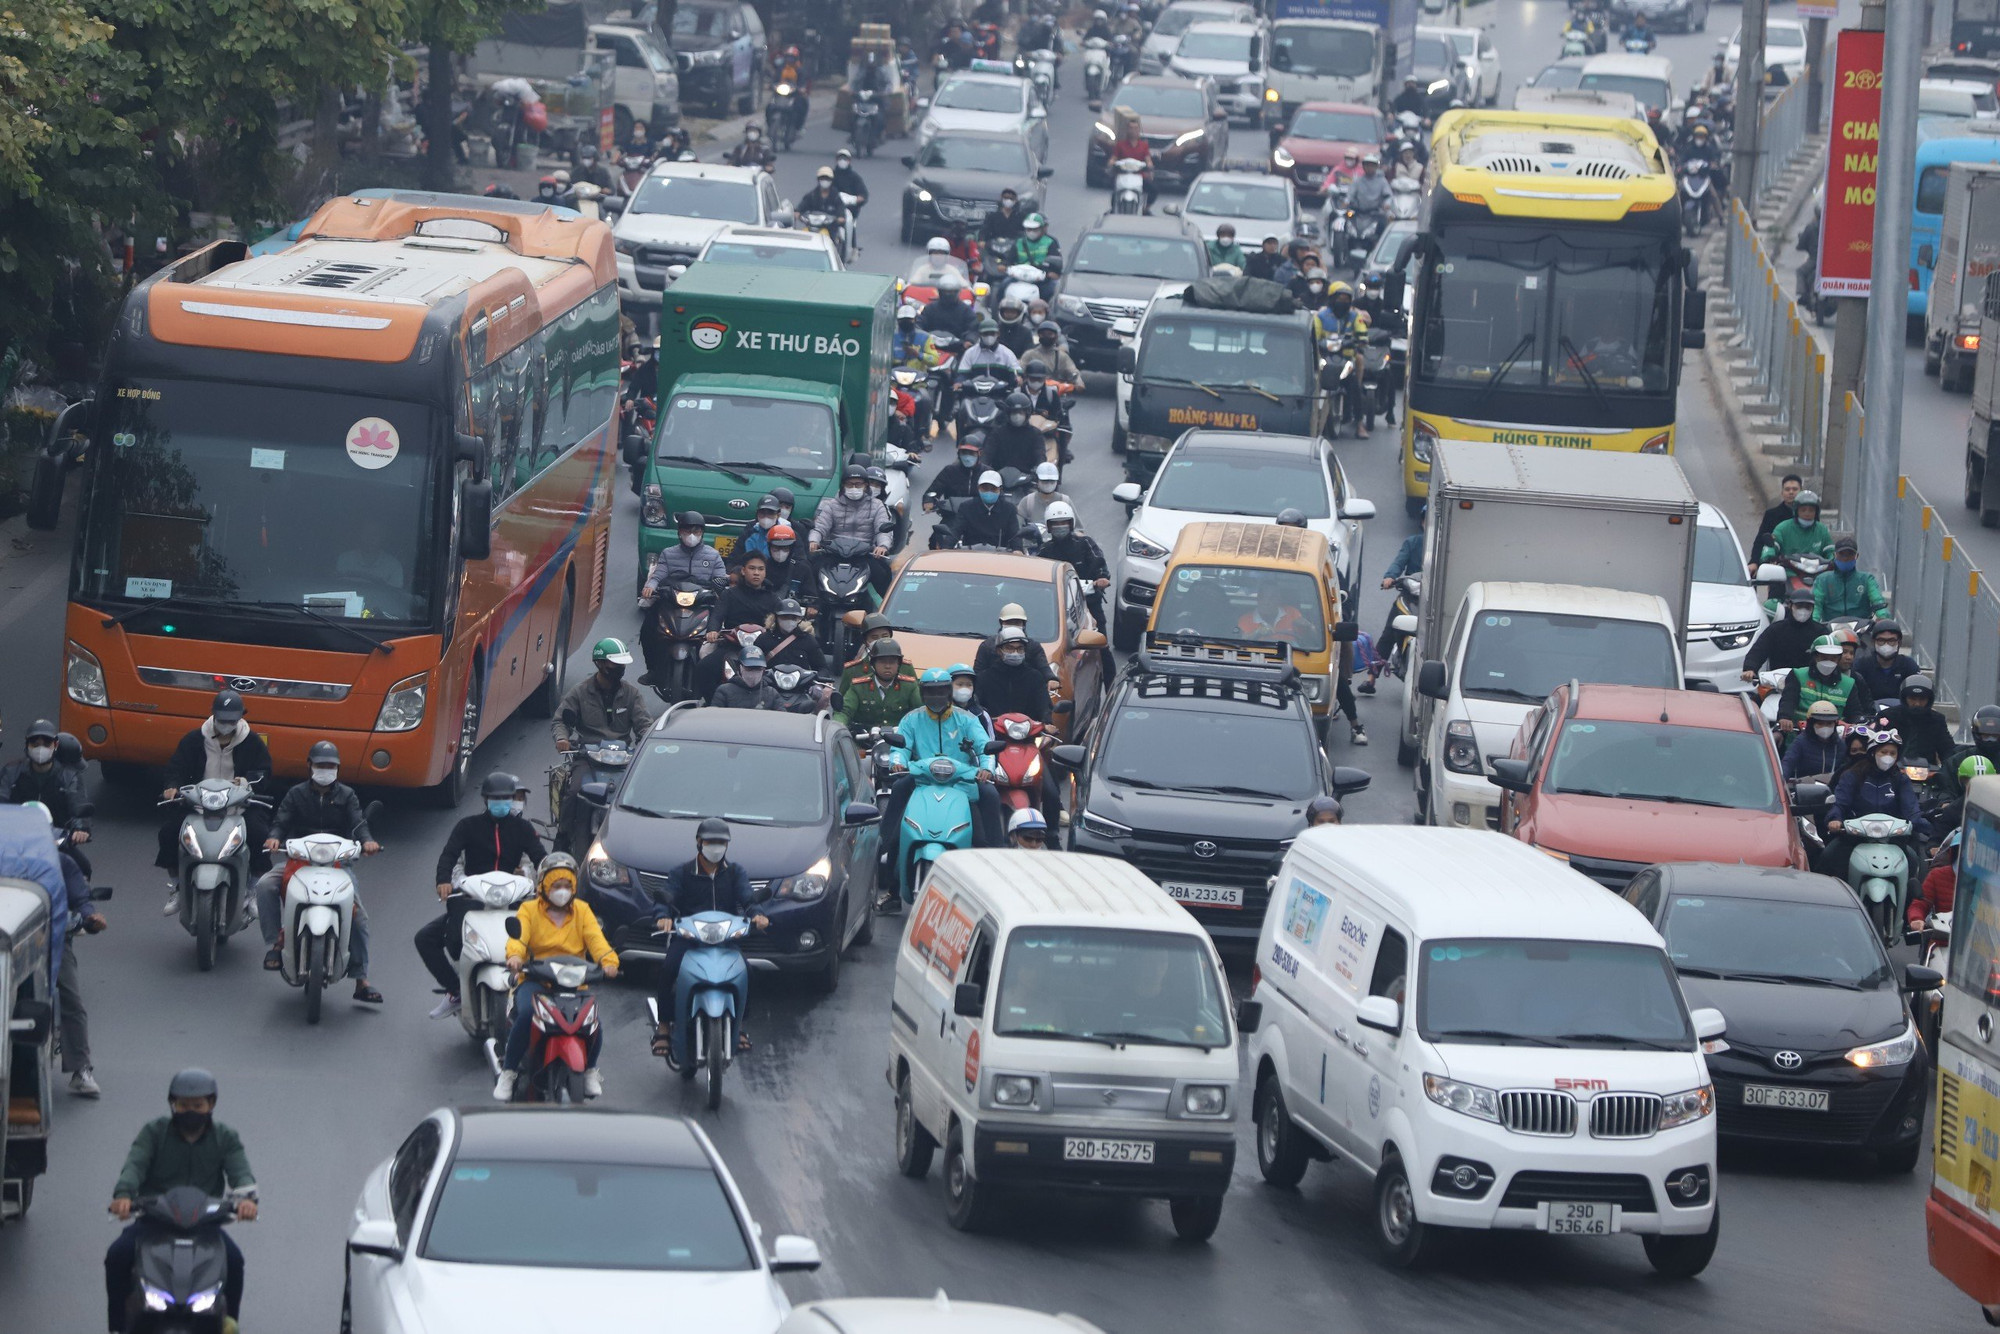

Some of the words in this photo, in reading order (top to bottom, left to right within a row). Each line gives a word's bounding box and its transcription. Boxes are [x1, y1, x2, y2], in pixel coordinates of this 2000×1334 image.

[1842, 118, 1879, 140] CHÀ
[736, 330, 762, 350] XE
[768, 333, 810, 353] THƯ
[814, 333, 860, 356] BÁO
[117, 388, 126, 397] XE
[127, 388, 141, 400] HỢP
[142, 388, 160, 400] ĐỒNG
[1213, 412, 1235, 428] MAI
[1240, 414, 1257, 430] KA
[1168, 886, 1236, 902] 28A-233.45
[1554, 1078, 1608, 1091] SRM
[1746, 1087, 1826, 1108] 30F-633.07
[1067, 1140, 1152, 1160] 29D-525.75
[1567, 1205, 1594, 1218] 29D
[1555, 1220, 1604, 1233] 536.46
